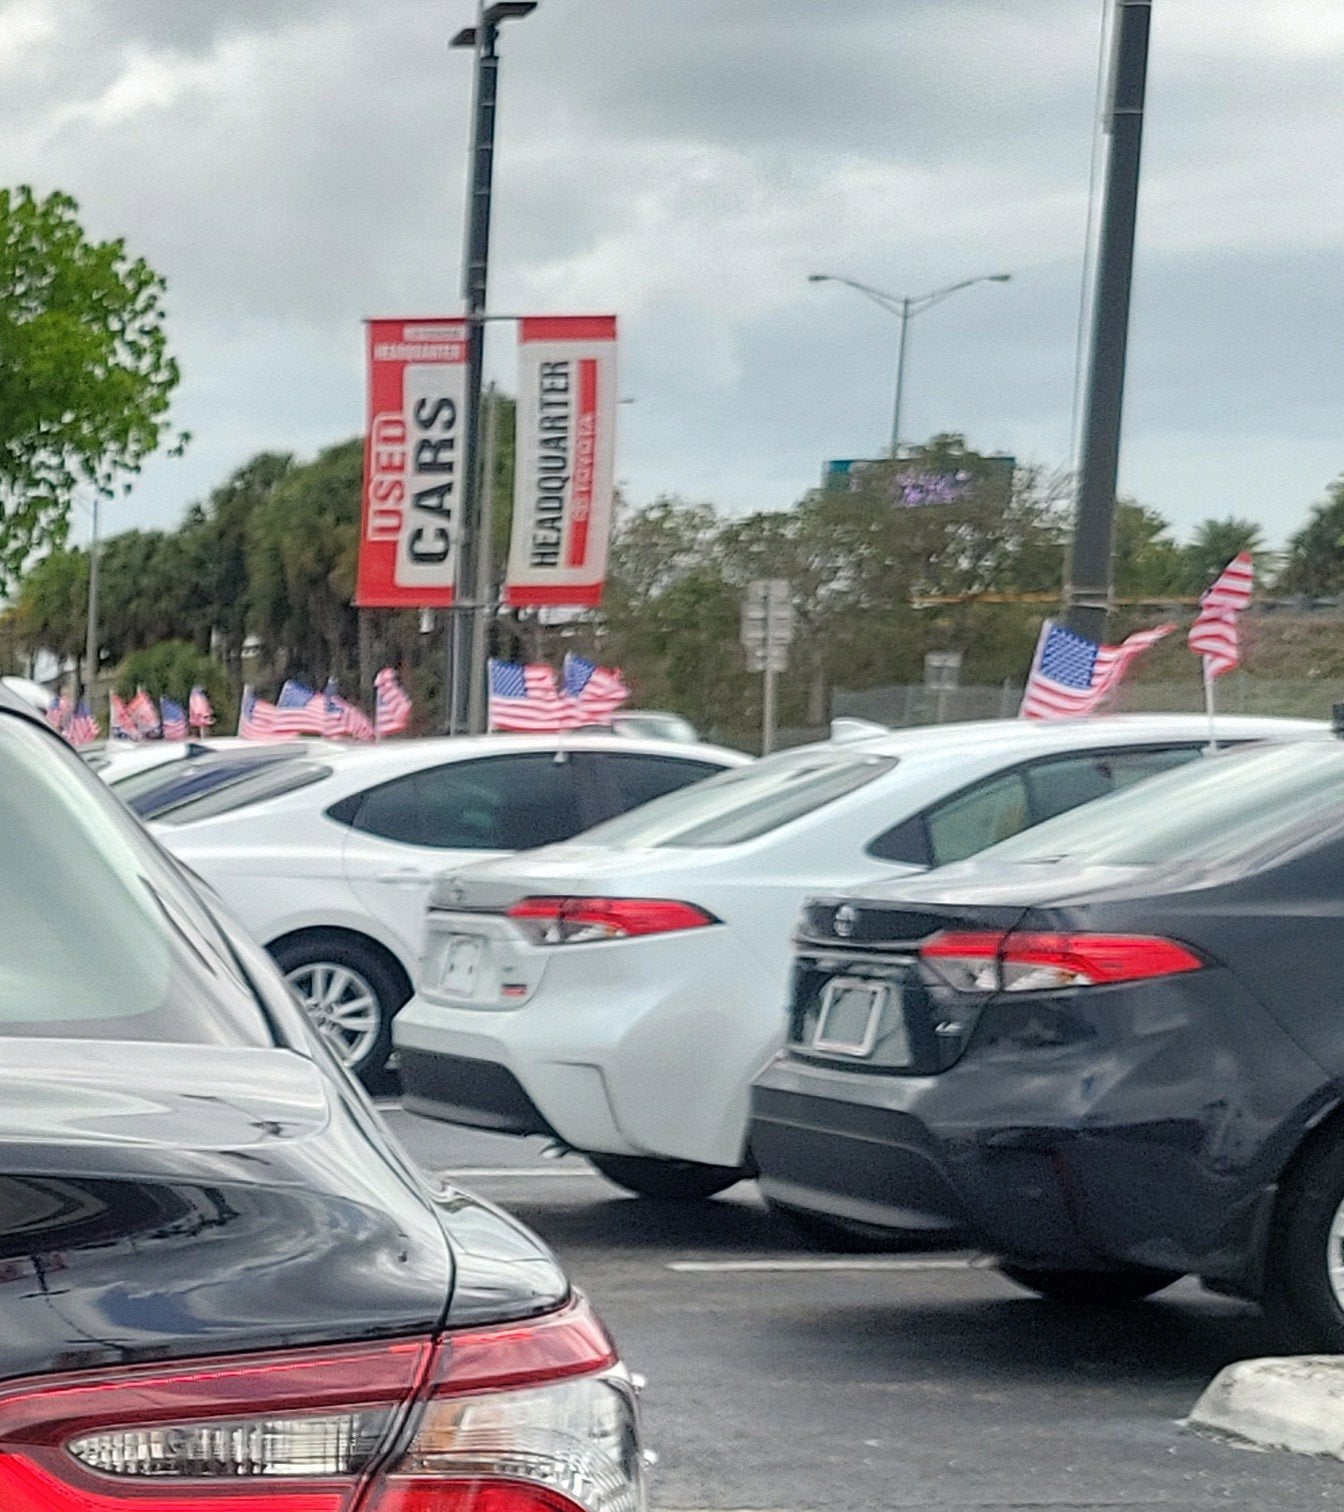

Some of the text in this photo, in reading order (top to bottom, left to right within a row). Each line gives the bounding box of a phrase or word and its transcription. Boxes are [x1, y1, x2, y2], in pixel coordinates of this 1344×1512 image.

[374, 417, 407, 535] USED
[409, 397, 457, 564] CARS
[529, 361, 571, 568] HEADQUARTER
